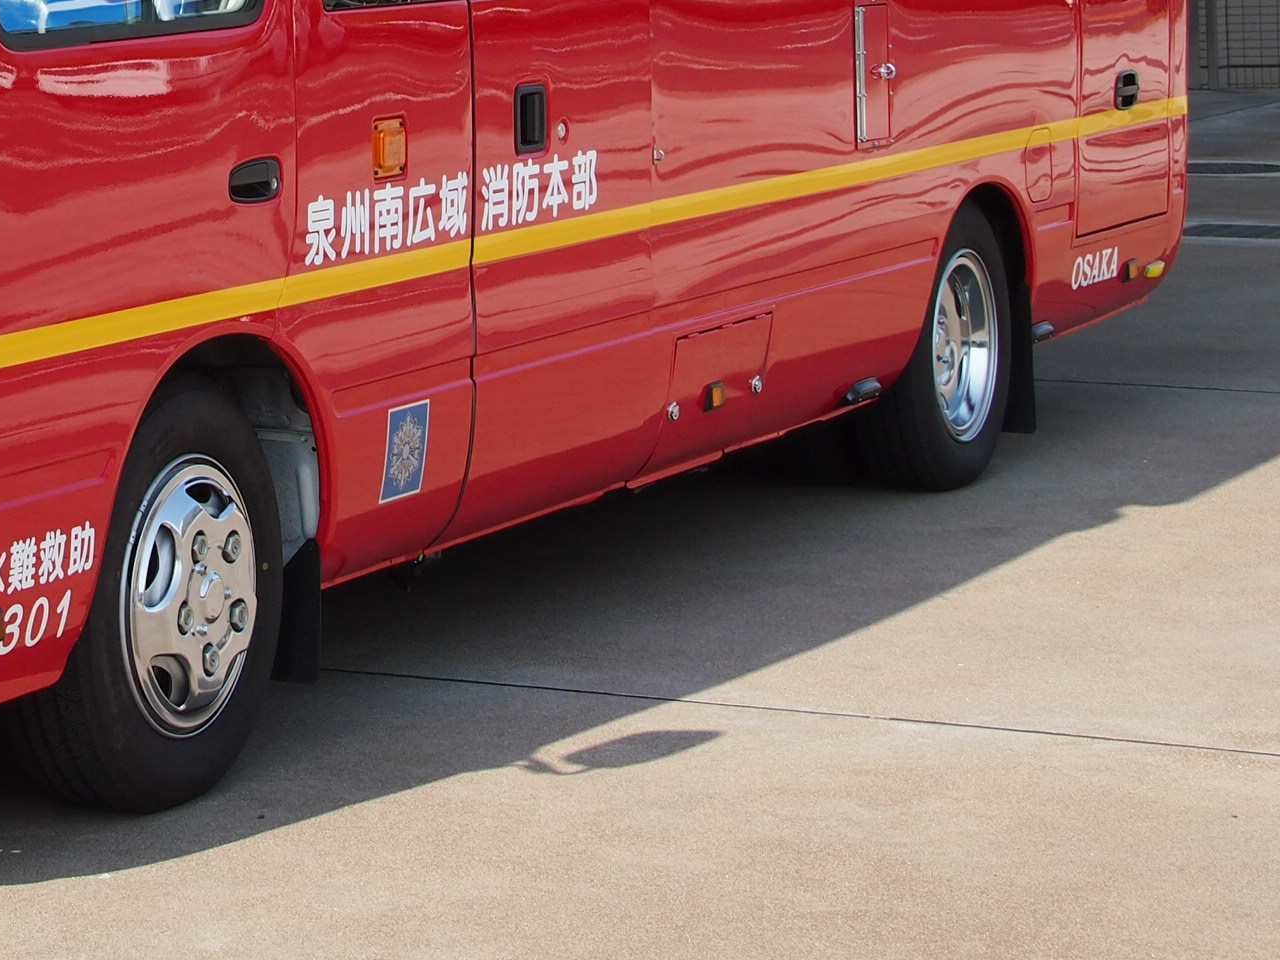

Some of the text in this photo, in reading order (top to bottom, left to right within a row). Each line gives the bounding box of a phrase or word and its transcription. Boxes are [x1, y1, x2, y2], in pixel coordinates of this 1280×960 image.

[304, 149, 598, 266] 泉州南広域 消防本部
[1071, 246, 1119, 291] OSAKA
